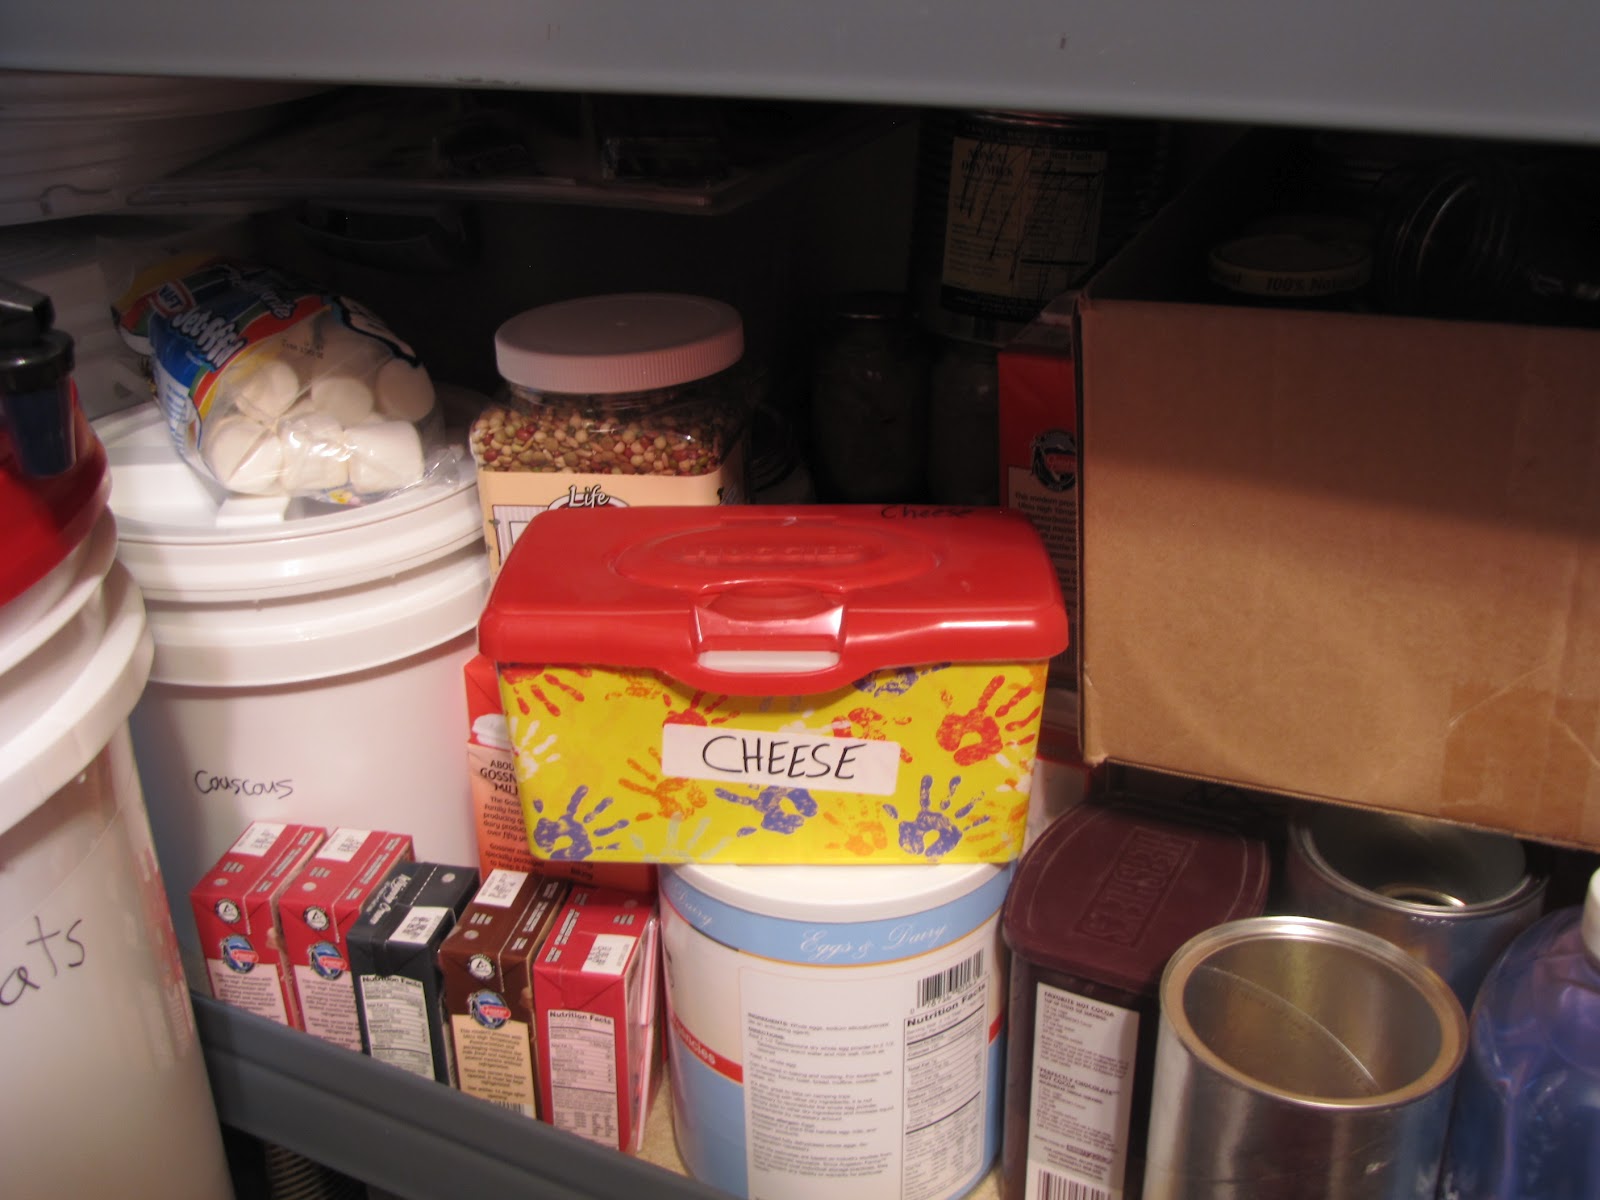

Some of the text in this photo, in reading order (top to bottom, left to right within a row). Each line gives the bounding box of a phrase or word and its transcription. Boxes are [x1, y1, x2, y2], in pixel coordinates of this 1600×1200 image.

[1265, 276, 1304, 291] 100%
[568, 484, 610, 508] Life
[880, 505, 976, 520] Cheese
[489, 759, 515, 772] ABOU
[702, 735, 868, 780] CHEESE
[194, 769, 294, 799] Couscous
[479, 767, 518, 785] GOSSN
[501, 824, 528, 835] product
[800, 929, 852, 961] Eggs
[882, 921, 950, 953] Dairy
[0, 915, 86, 1006] ats
[906, 1001, 960, 1027] Nutrition
[960, 982, 987, 1005] Facts
[549, 1010, 612, 1025] Nutrition Facts
